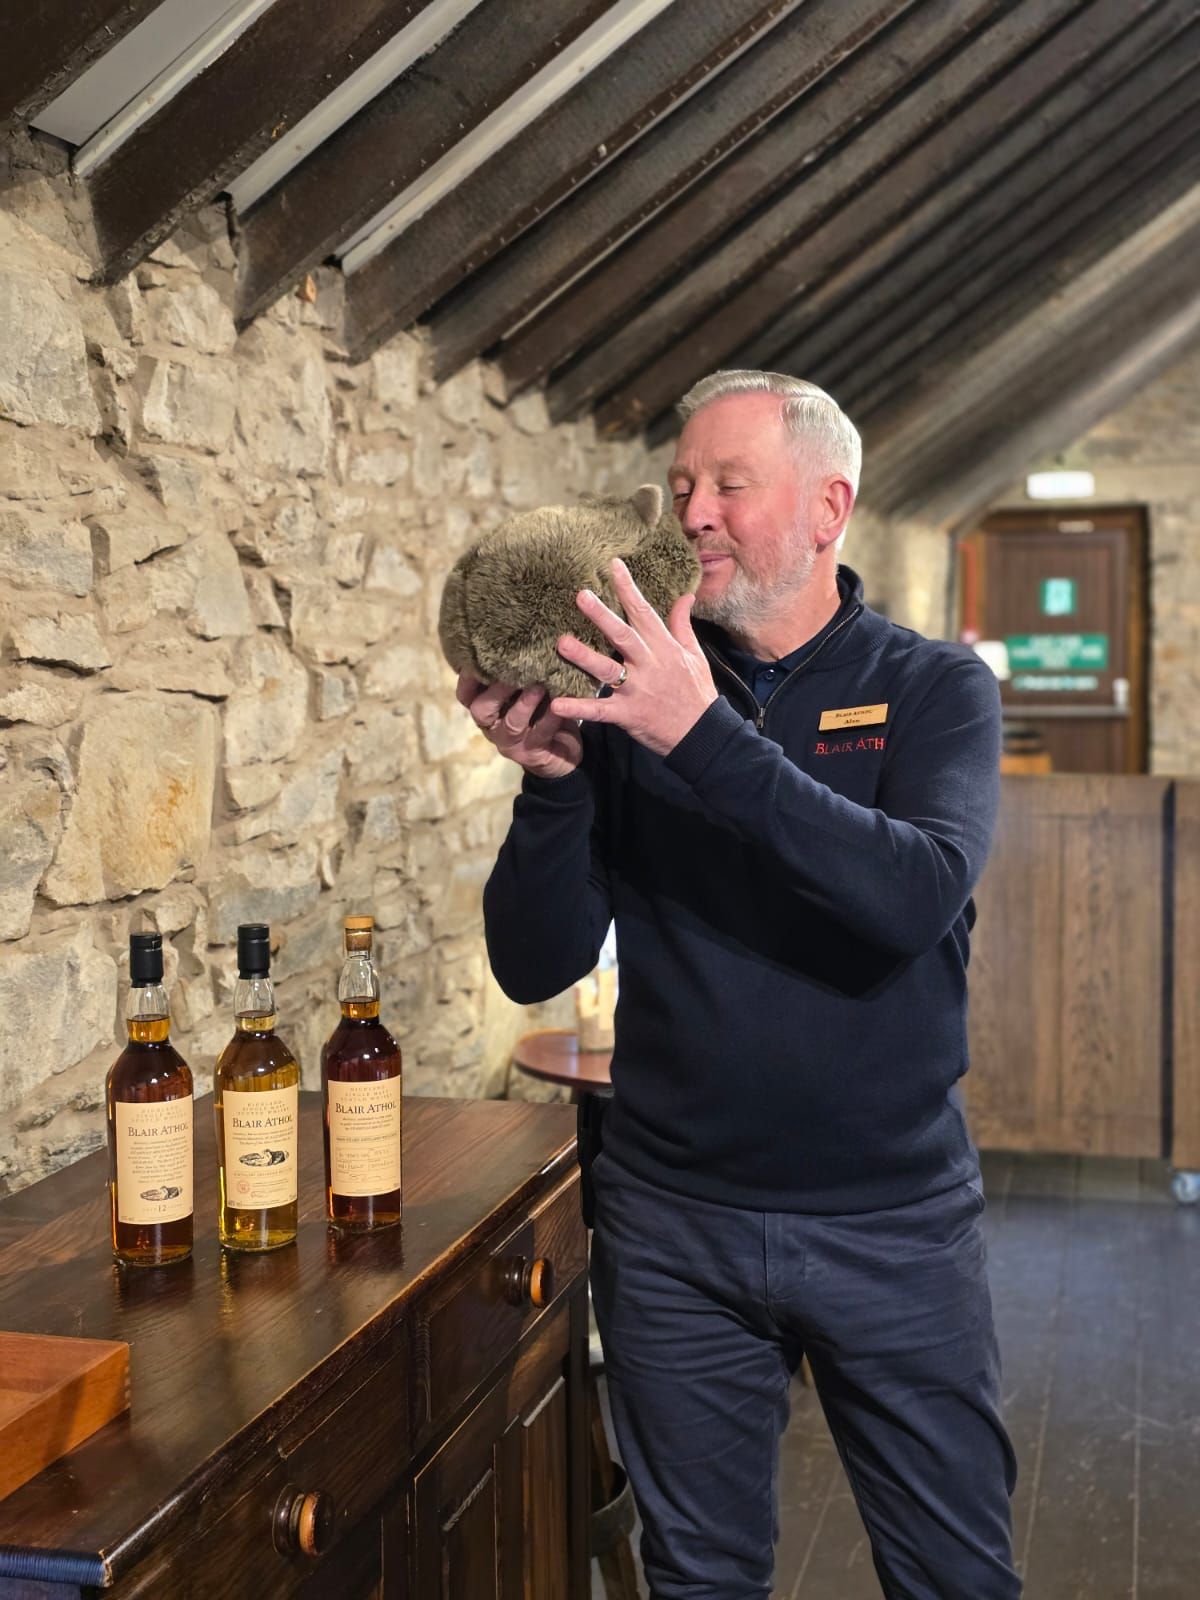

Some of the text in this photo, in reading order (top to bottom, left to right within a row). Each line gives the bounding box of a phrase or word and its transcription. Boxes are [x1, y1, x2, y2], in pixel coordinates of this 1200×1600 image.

[815, 737, 885, 755] BLAIR ATH
[335, 1101, 396, 1114] BLAIR ATHOL
[232, 1114, 292, 1128] BLAIR ATHOL
[128, 1123, 188, 1137] BLAIR ATHOL
[158, 1204, 167, 1212] 12
